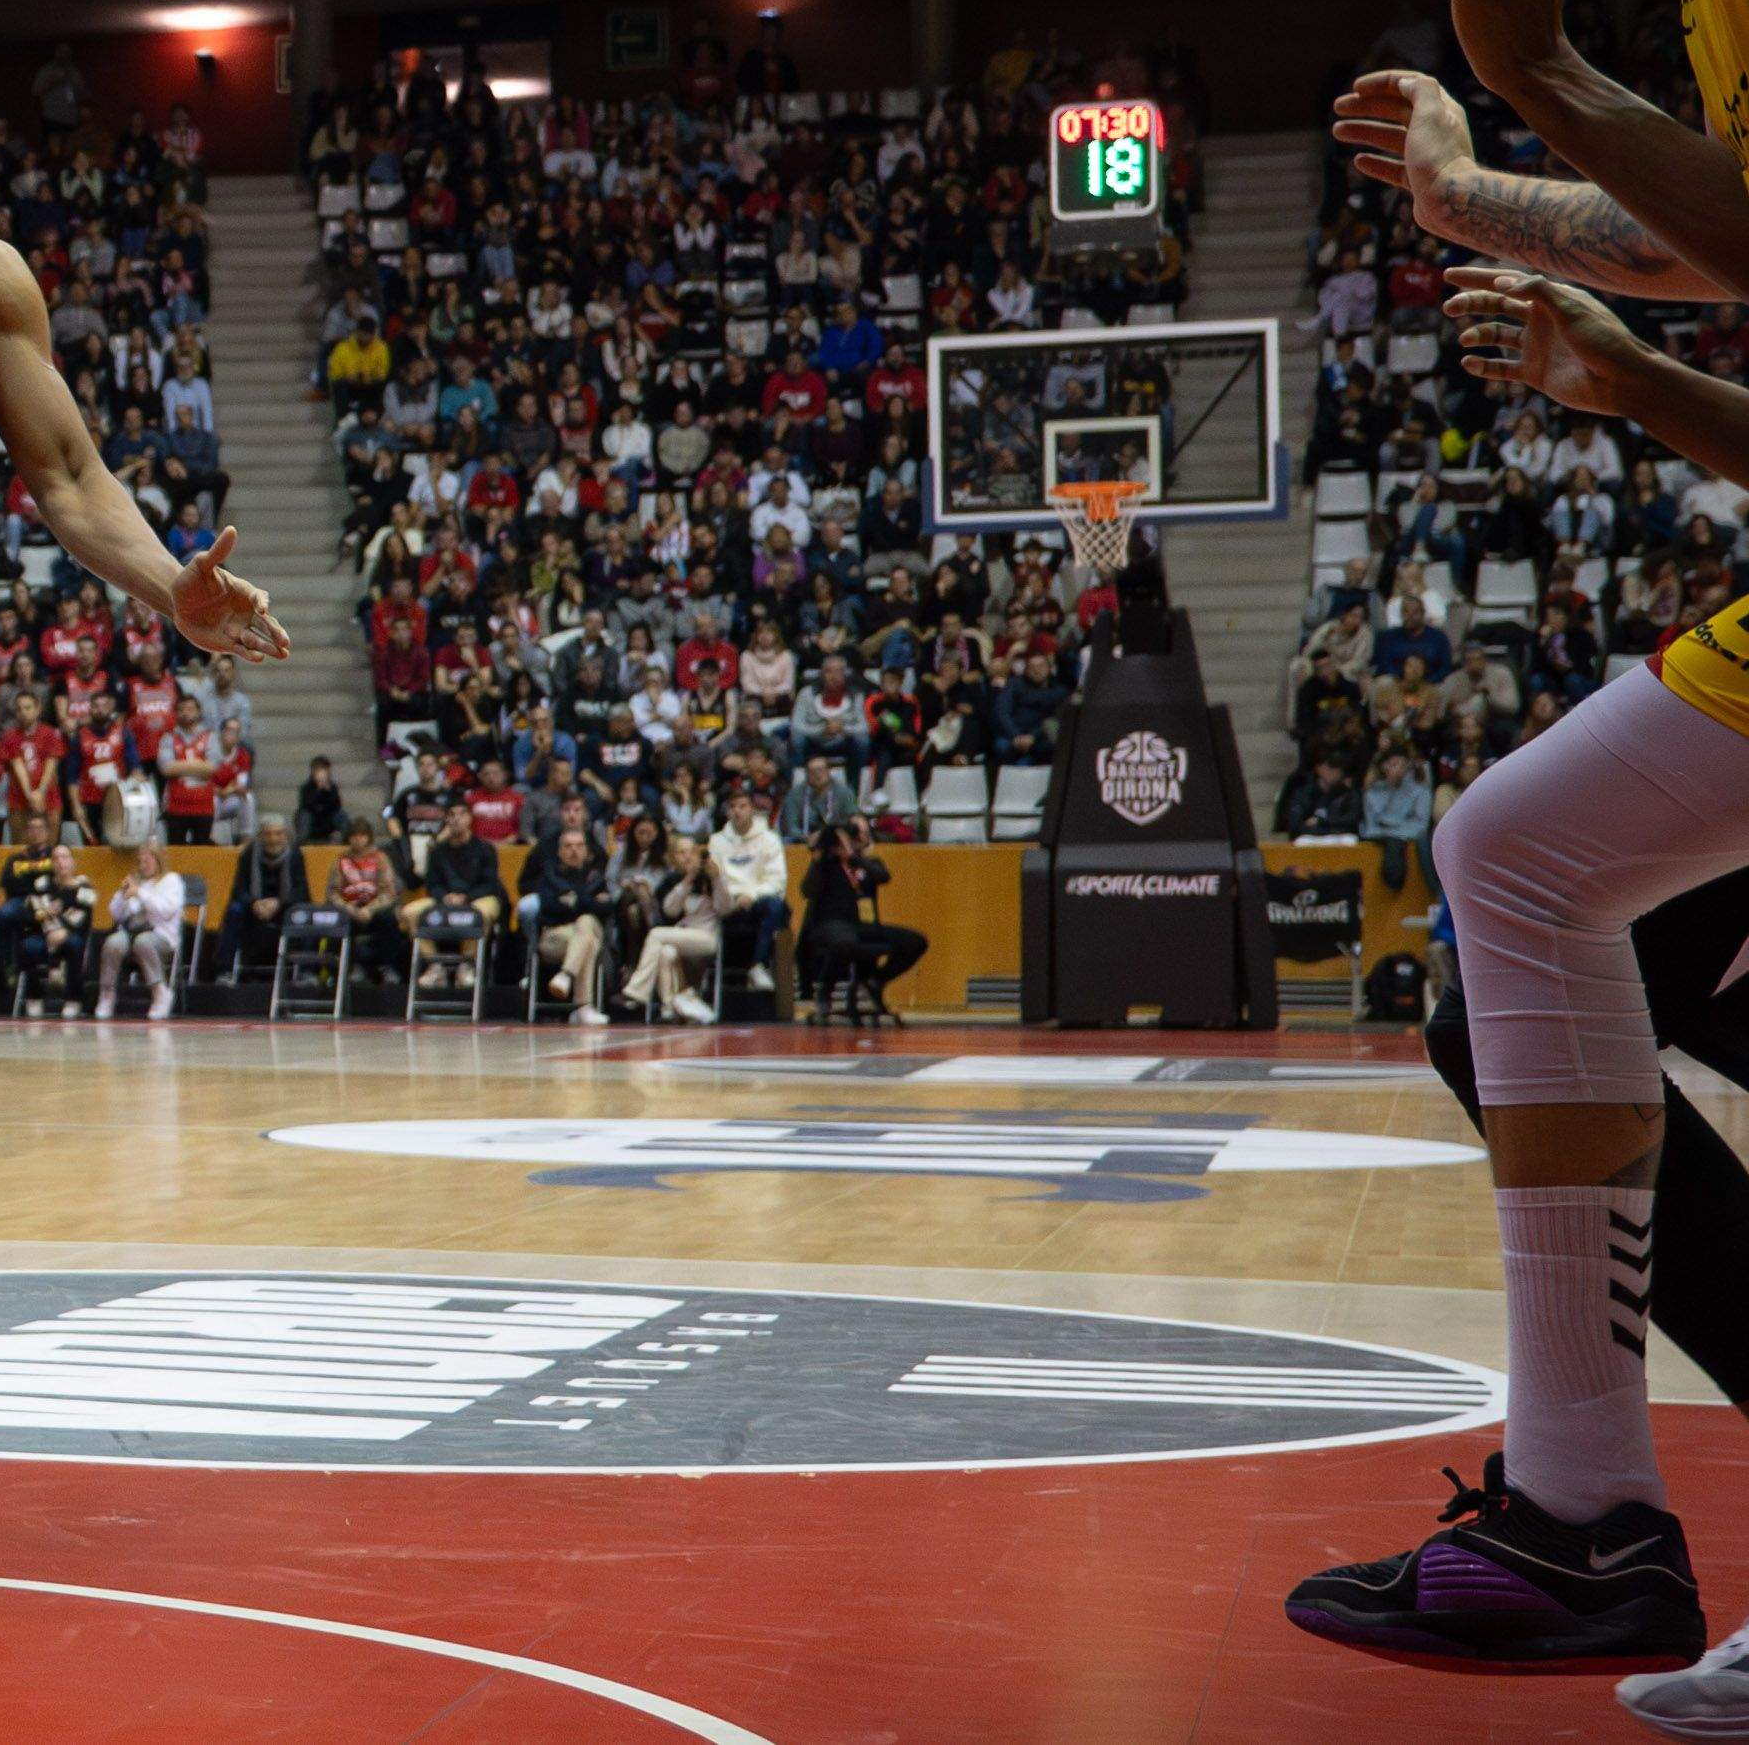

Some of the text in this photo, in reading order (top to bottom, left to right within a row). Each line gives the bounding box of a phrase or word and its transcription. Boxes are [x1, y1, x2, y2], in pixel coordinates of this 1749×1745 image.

[1058, 105, 1151, 144] 07:30
[1087, 136, 1144, 197] 18
[1102, 778, 1183, 806] GIRONA
